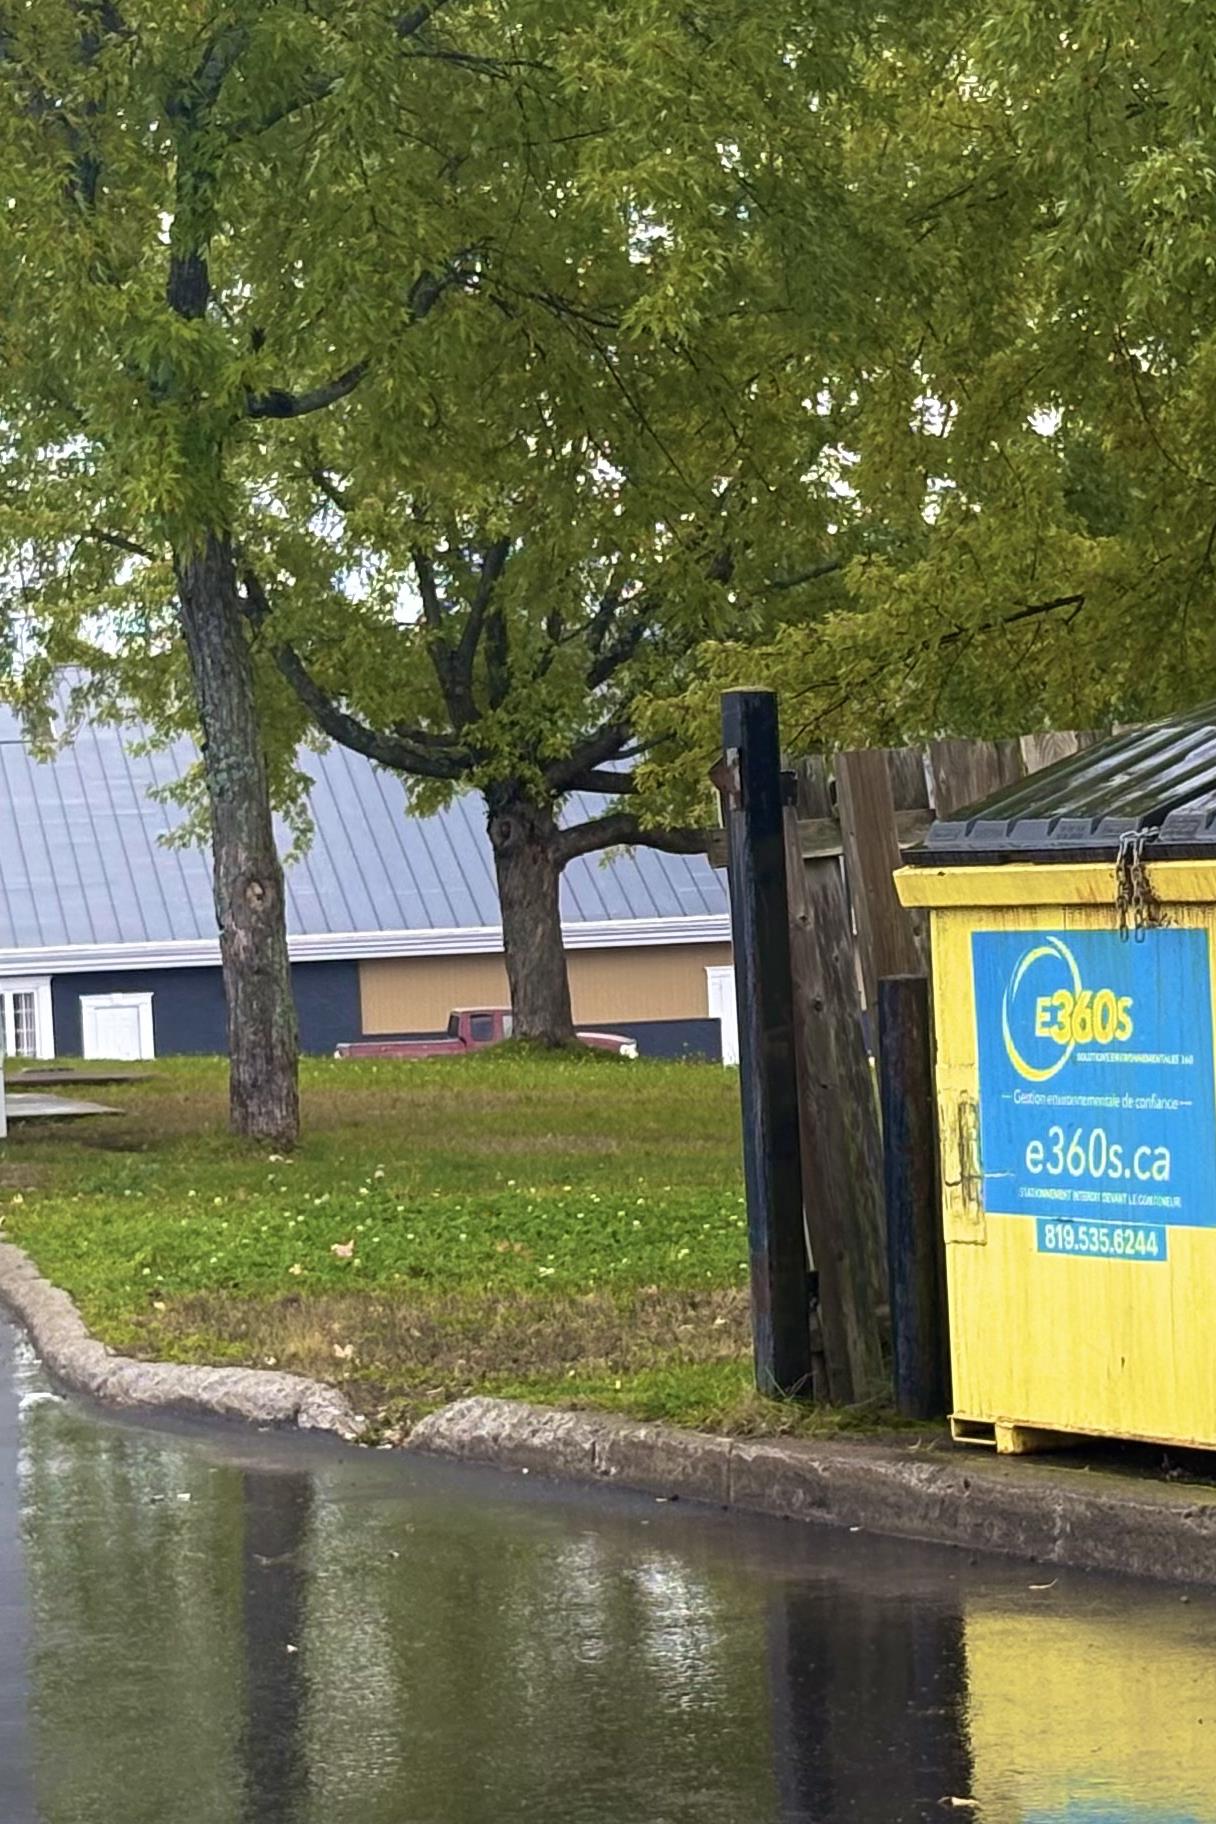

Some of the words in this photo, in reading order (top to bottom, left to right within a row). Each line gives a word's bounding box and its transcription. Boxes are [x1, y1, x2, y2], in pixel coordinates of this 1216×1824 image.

[1035, 988, 1134, 1044] E360S
[1013, 1088, 1046, 1105] Gestion
[1121, 1092, 1133, 1108] de
[1135, 1093, 1179, 1110] confiance
[1025, 1126, 1171, 1181] e360s.ca
[1045, 1223, 1159, 1257] 819.535.6244
